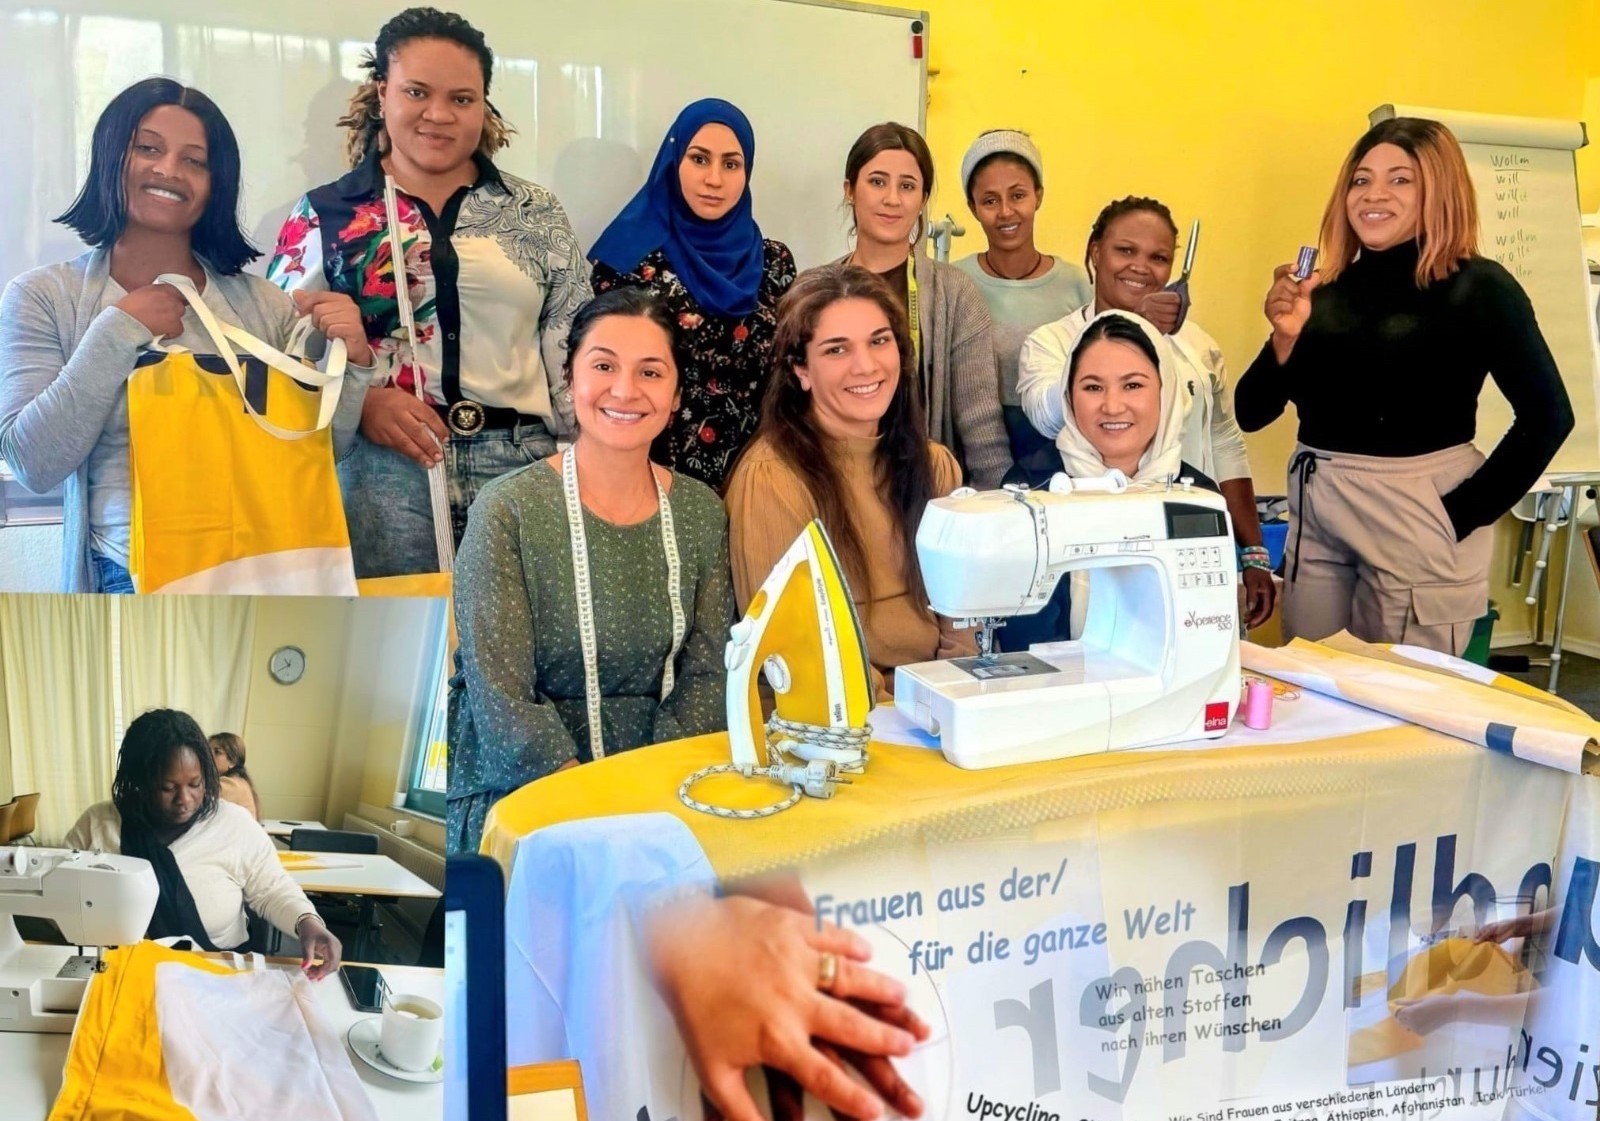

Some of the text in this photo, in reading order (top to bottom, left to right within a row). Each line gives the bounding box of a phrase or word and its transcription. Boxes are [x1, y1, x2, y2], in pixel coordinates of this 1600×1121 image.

[1205, 717, 1227, 728] elna
[814, 889, 923, 932] Frauen
[937, 881, 985, 912] aus
[908, 899, 1197, 975] für die ganze Welt
[1095, 961, 1266, 1001] Wir nähen Taschen
[1098, 992, 1252, 1027] aus alten Stoffen
[1100, 1017, 1282, 1052] nach ihren Wünschen
[1227, 1106, 1269, 1120] Frauen
[1272, 1101, 1293, 1114] aus
[1295, 1089, 1383, 1110] verschiedenen
[1386, 1081, 1436, 1098] Ländern
[1391, 1096, 1465, 1116] Afghanistan
